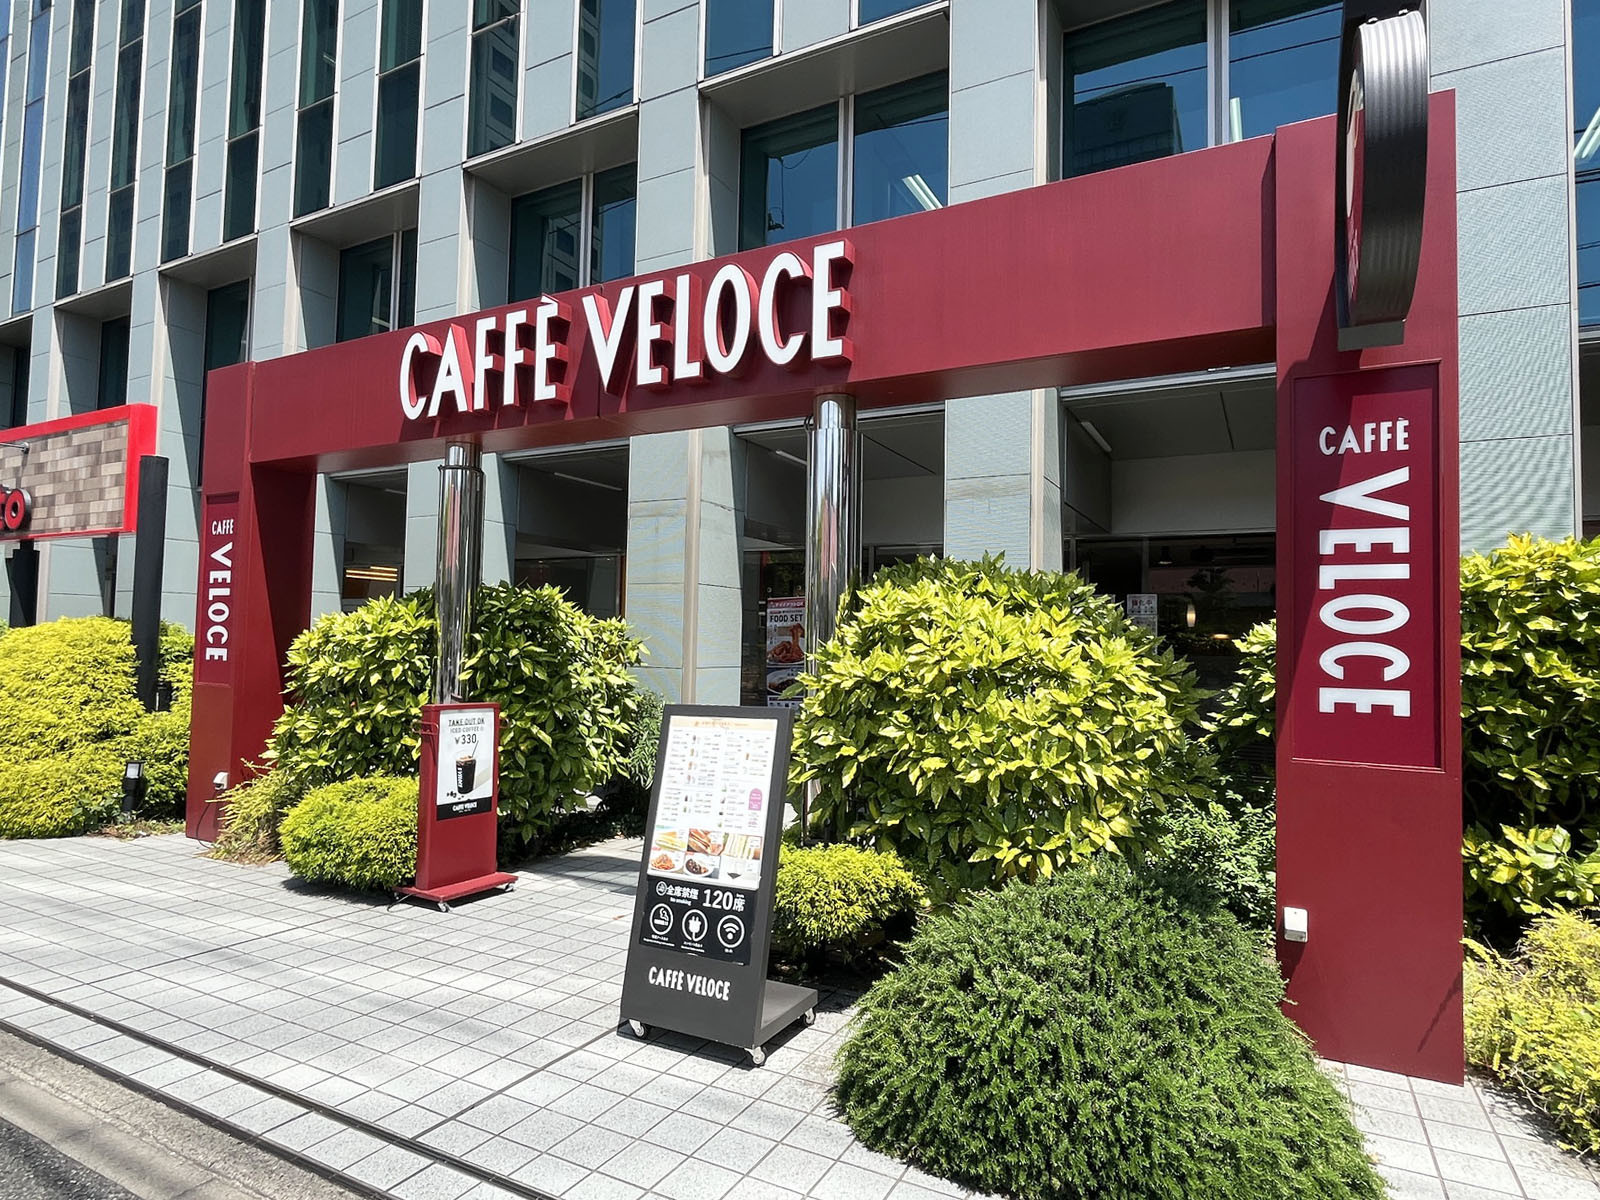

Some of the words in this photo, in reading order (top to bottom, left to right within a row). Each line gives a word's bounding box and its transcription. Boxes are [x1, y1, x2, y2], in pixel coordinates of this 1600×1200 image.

[400, 295, 560, 420] CAFFÈ
[581, 240, 849, 393] VELOCE
[1319, 417, 1410, 456] CAFFÈ
[205, 541, 233, 661] VELOCE
[1319, 465, 1411, 718] VELOCE
[770, 614, 788, 622] FOOD
[790, 613, 804, 622] SET
[448, 719, 463, 727] TAKE
[666, 885, 699, 900] 全席禁煙
[686, 973, 731, 1001] VELOCE
